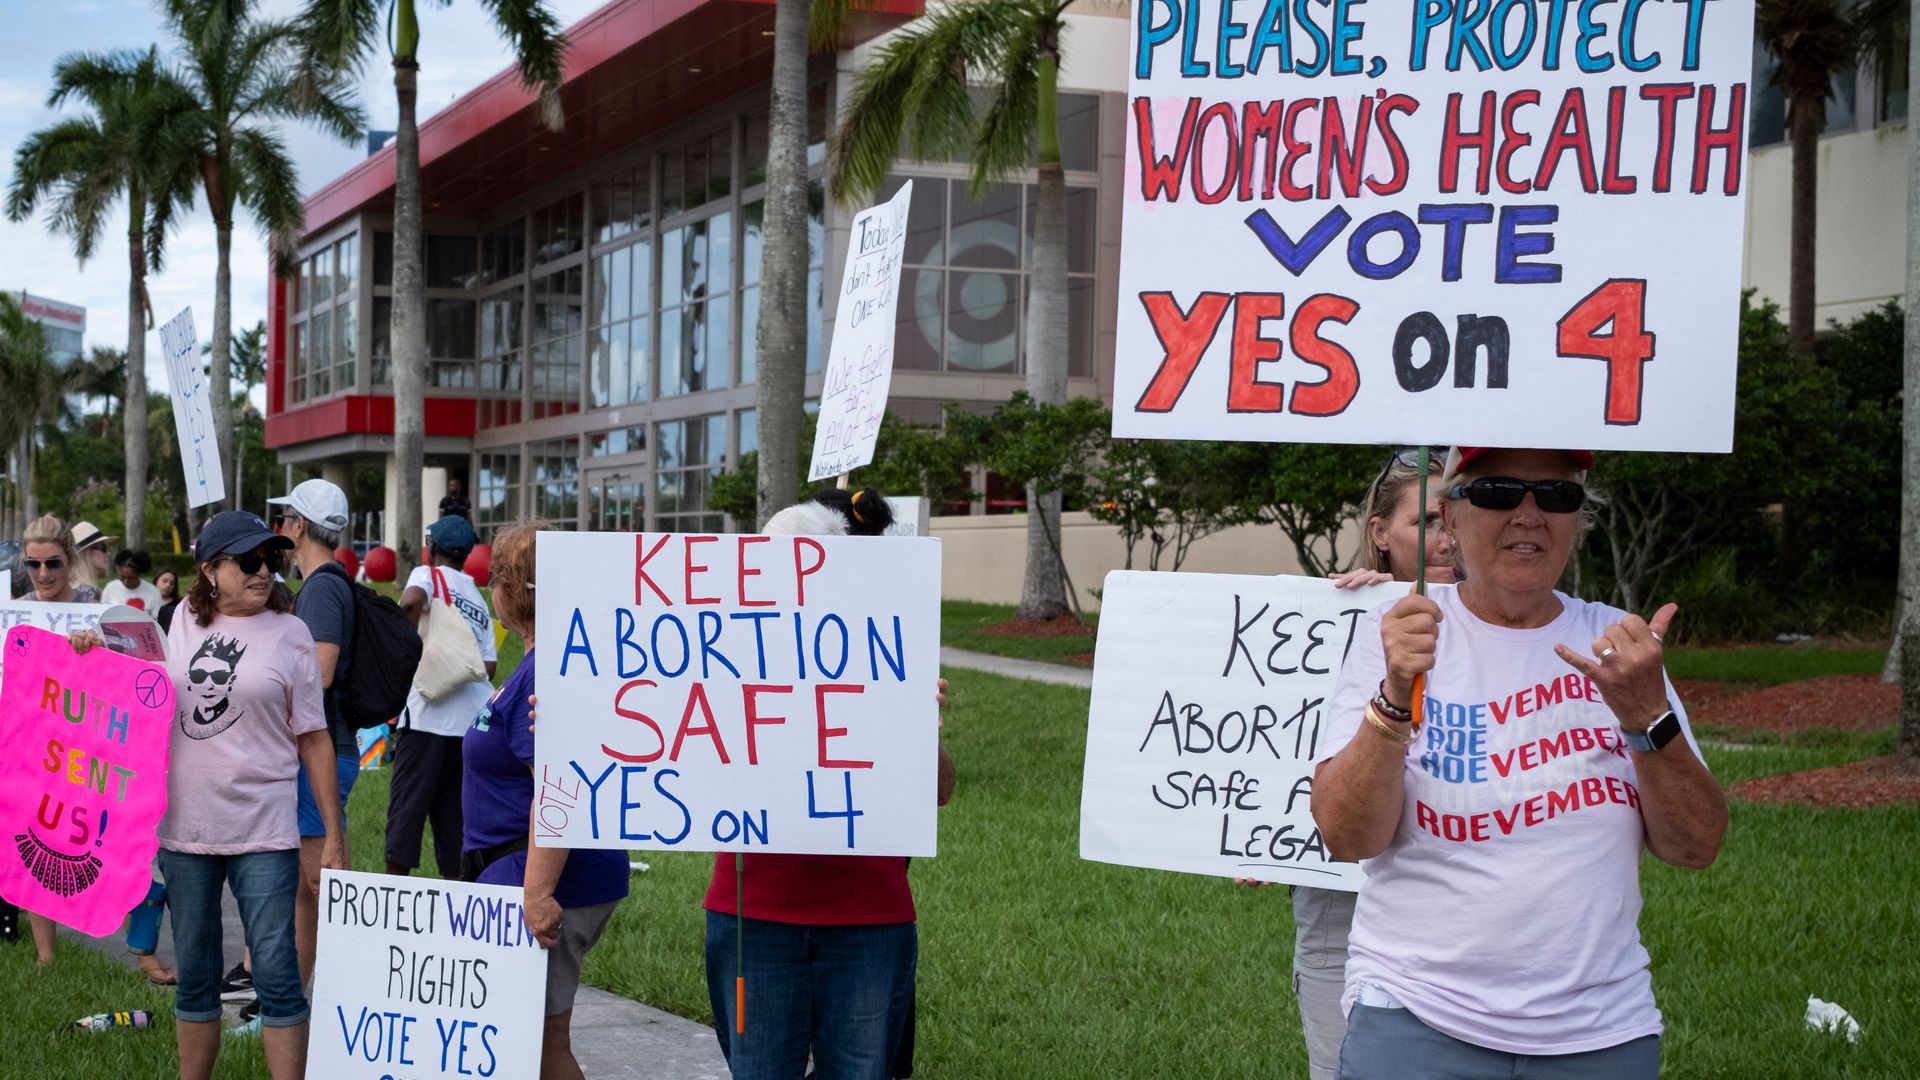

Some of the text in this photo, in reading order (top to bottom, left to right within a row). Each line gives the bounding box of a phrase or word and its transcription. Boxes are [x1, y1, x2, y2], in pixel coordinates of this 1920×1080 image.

[1134, 0, 1718, 79] PLEASE, PROTECT
[1133, 82, 1748, 205] WOMEN'S HEALTH
[1244, 202, 1562, 284] VOTE
[1134, 278, 1656, 425] YES on 4
[635, 534, 826, 606] KEEP
[559, 607, 906, 682] ABORTION
[40, 676, 129, 744] RUTH
[601, 679, 874, 769] SAFE
[1139, 690, 1325, 761] ABORTI
[42, 739, 137, 801] SENT
[536, 764, 582, 838] VOTE
[569, 761, 864, 848] YES ON 4
[37, 793, 109, 848] US!
[328, 877, 440, 934] PROTECT
[387, 945, 489, 1009] RIGHTS
[337, 1005, 498, 1078] VOTE YES
